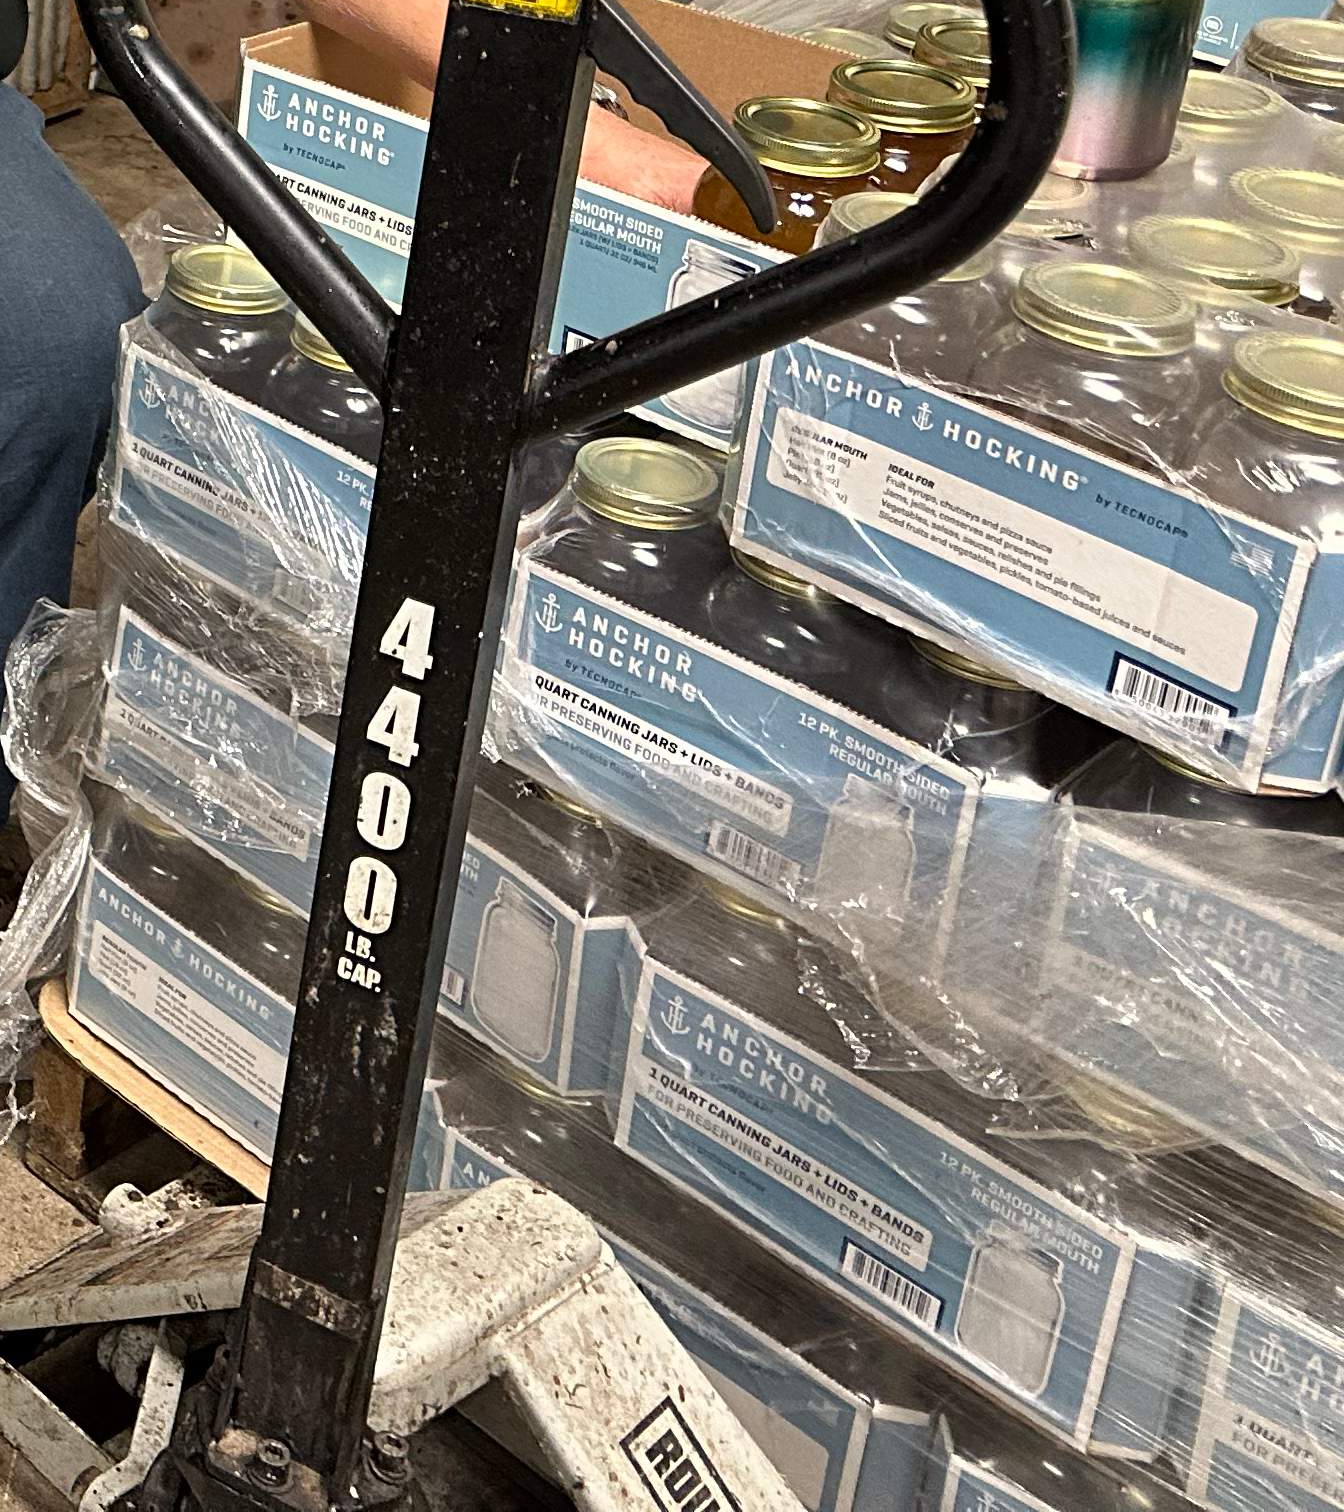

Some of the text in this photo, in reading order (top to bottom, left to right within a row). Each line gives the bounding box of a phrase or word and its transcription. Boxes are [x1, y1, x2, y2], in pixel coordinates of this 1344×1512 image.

[285, 113, 392, 166] HOCKING
[288, 92, 385, 142] ANCHOR
[283, 142, 294, 153] by
[297, 182, 346, 210] CANNING
[347, 199, 377, 223] JARS
[387, 219, 413, 236] LIDS
[342, 216, 372, 237] FOOD
[373, 229, 398, 247] AND
[572, 197, 664, 240] SMOOTH SIDED
[616, 227, 662, 255] MOUTH
[785, 360, 903, 418] ANCHOR
[943, 419, 1084, 492] HOCKING
[1095, 493, 1110, 509] by
[834, 441, 868, 460] MOUTH
[139, 448, 174, 476] QUART
[219, 487, 249, 513] JARS
[336, 470, 352, 485] 12
[888, 463, 936, 489] IDEAL FOR
[981, 516, 999, 530] and
[985, 532, 1002, 545] and
[930, 533, 947, 547] and
[1131, 623, 1151, 638] and
[1034, 567, 1052, 580] and
[564, 658, 578, 672] by
[568, 627, 698, 703] HOCKING
[572, 607, 692, 676] ANCHOR
[153, 653, 238, 714] ANCHOR
[535, 674, 579, 705] QUART
[580, 698, 640, 736] CANNING
[641, 729, 678, 755] JARS
[690, 752, 722, 778] LIDS
[735, 776, 785, 810] BANDS
[550, 698, 632, 751] PRESERVING
[634, 741, 671, 769] FOOD
[798, 712, 818, 727] 12
[843, 735, 904, 774] SMOOTH
[906, 771, 951, 801] SIDED
[343, 597, 435, 935] 4400
[829, 745, 893, 786] REGULAR
[98, 886, 166, 945] ANCHOR
[189, 952, 271, 1021] HOCKING
[344, 930, 376, 963] LB.
[337, 956, 381, 992] CAP.
[700, 1013, 829, 1096] ANCHOR
[646, 1085, 674, 1110] FOR
[676, 1099, 763, 1164] PRESERVING
[764, 1155, 804, 1187] FOOD
[805, 1183, 837, 1210] AND
[839, 1202, 912, 1258] CRAFTING
[649, 1067, 657, 1080] 1
[659, 1073, 707, 1108] QUART
[707, 1102, 771, 1149] CANNING
[772, 1141, 812, 1173] JARS
[823, 1174, 858, 1205] LIDS
[870, 1203, 924, 1245] BANDS
[939, 1151, 959, 1169] 12
[988, 1181, 1054, 1229] SMOOTH
[970, 1187, 1042, 1239] REGULAR
